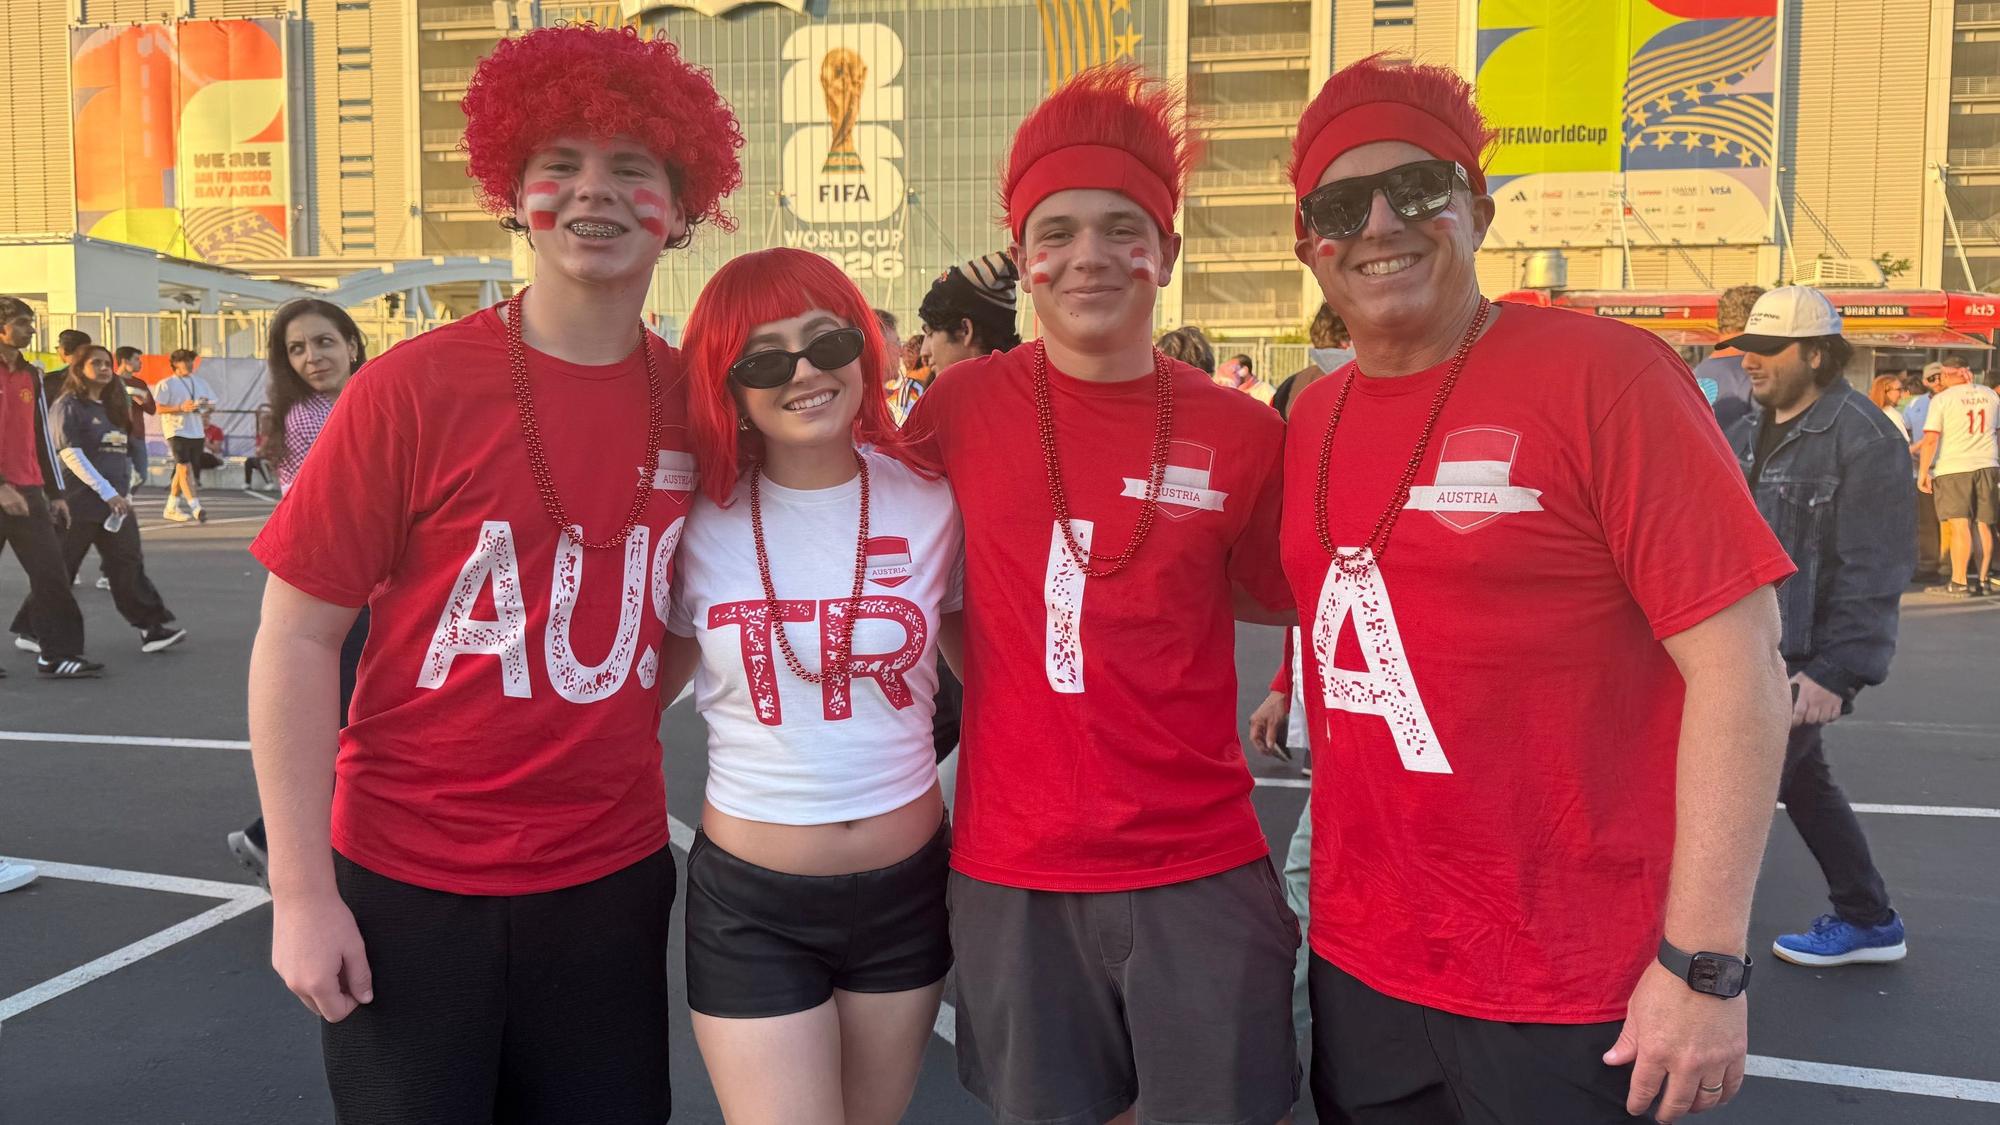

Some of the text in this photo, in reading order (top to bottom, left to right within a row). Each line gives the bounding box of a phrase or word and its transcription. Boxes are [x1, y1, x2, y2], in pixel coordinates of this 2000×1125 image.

[194, 153, 225, 168] WE
[228, 185, 272, 198] AREA
[819, 185, 870, 202] FIFA
[1709, 186, 1732, 195] VISA
[784, 228, 904, 248] WORLD CUP
[818, 250, 904, 279] 26
[1967, 409, 1985, 434] 11
[1158, 487, 1201, 502] USTRIA
[1437, 491, 1498, 504] AUSTRIA
[872, 567, 907, 576] AUSTRIA
[707, 595, 928, 726] TR
[1312, 546, 1454, 774] A
